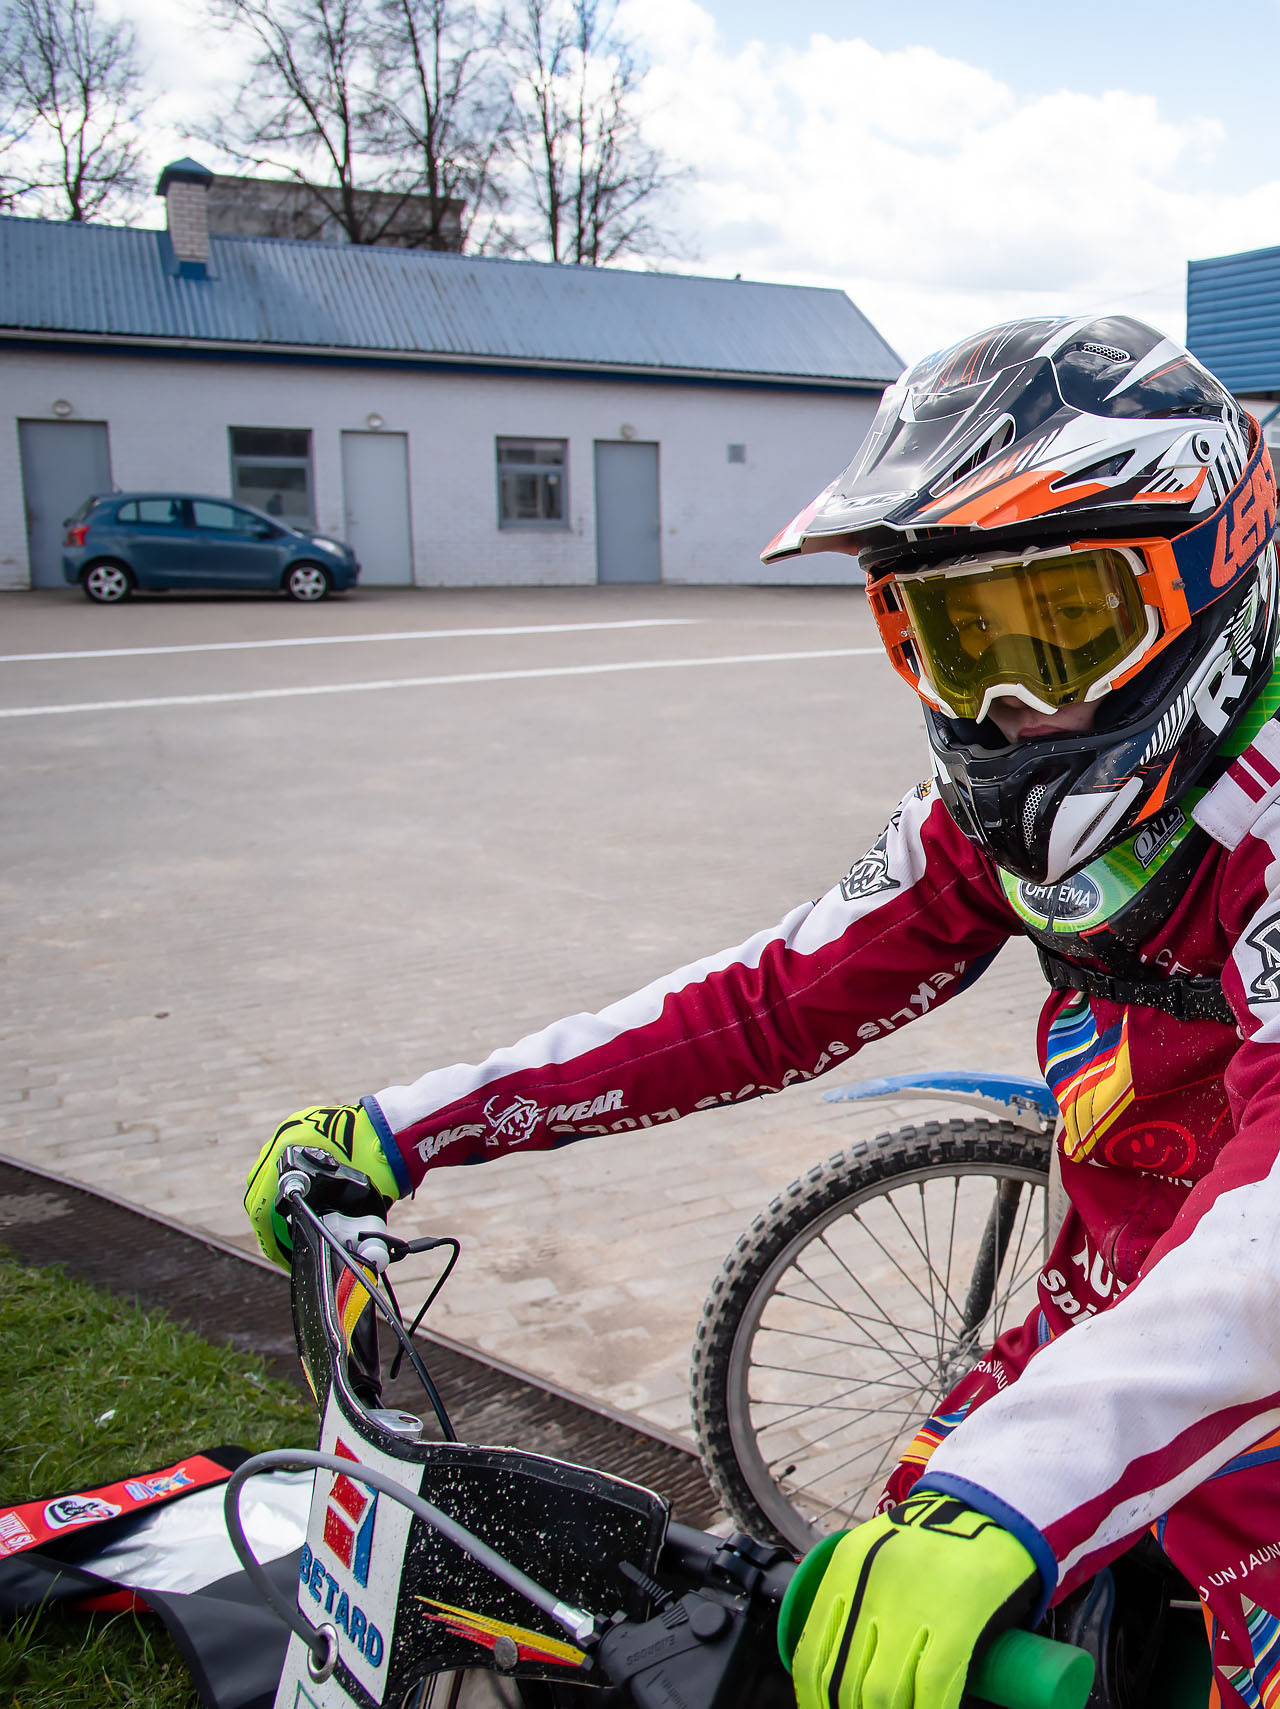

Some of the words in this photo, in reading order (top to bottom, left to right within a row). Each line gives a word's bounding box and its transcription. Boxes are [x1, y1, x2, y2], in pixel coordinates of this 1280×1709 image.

[412, 1123, 488, 1163] RACE
[546, 1088, 630, 1126] WEAR
[300, 1541, 385, 1669] BETARD
[1208, 1566, 1237, 1587] UN
